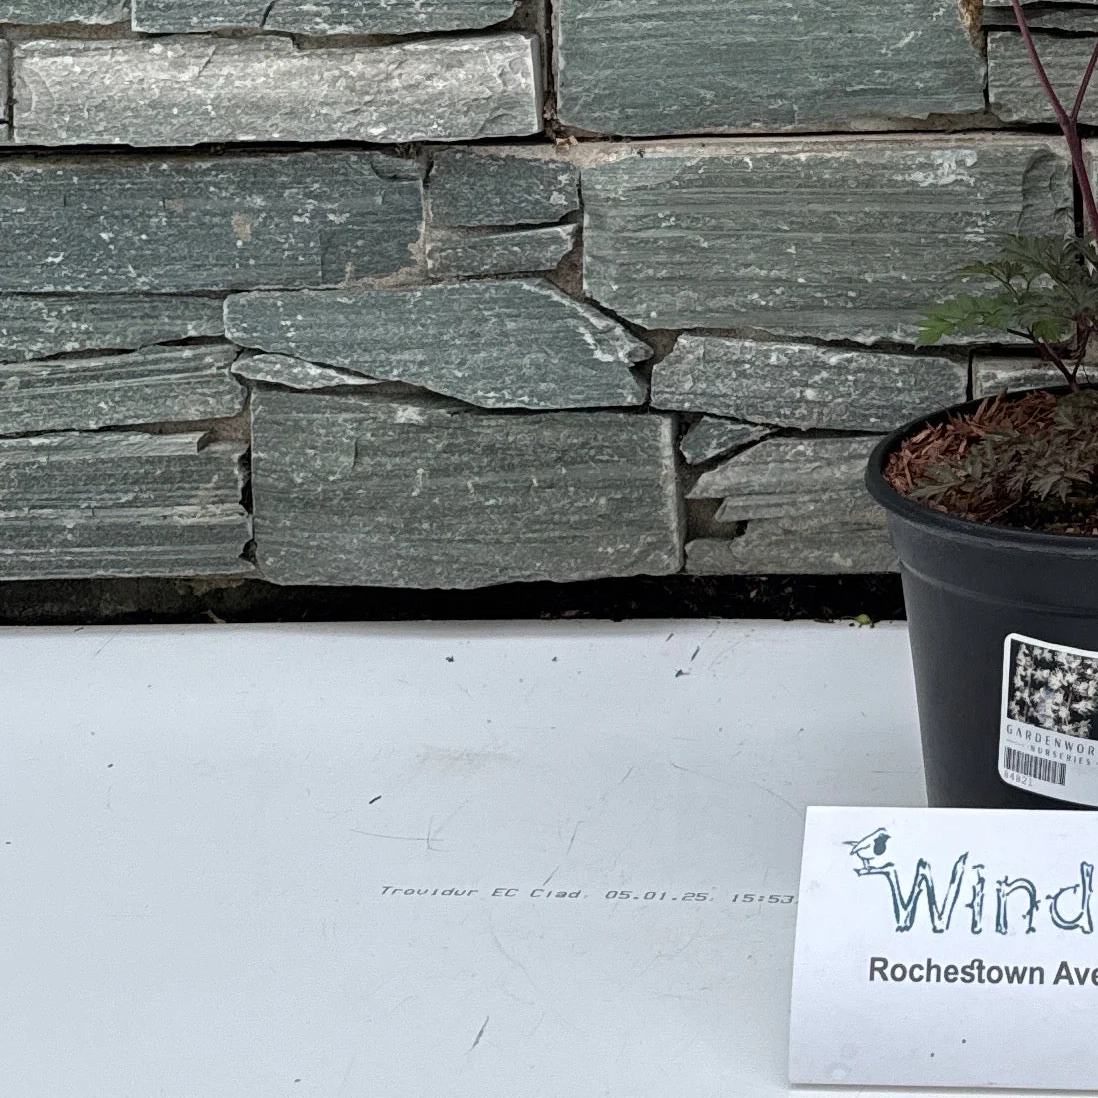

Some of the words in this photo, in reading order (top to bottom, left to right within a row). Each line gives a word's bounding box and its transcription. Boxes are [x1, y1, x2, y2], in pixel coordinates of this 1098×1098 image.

[1030, 745, 1091, 766] NURSERIES
[491, 888, 519, 898] EC
[868, 957, 1045, 987] Rochestown
